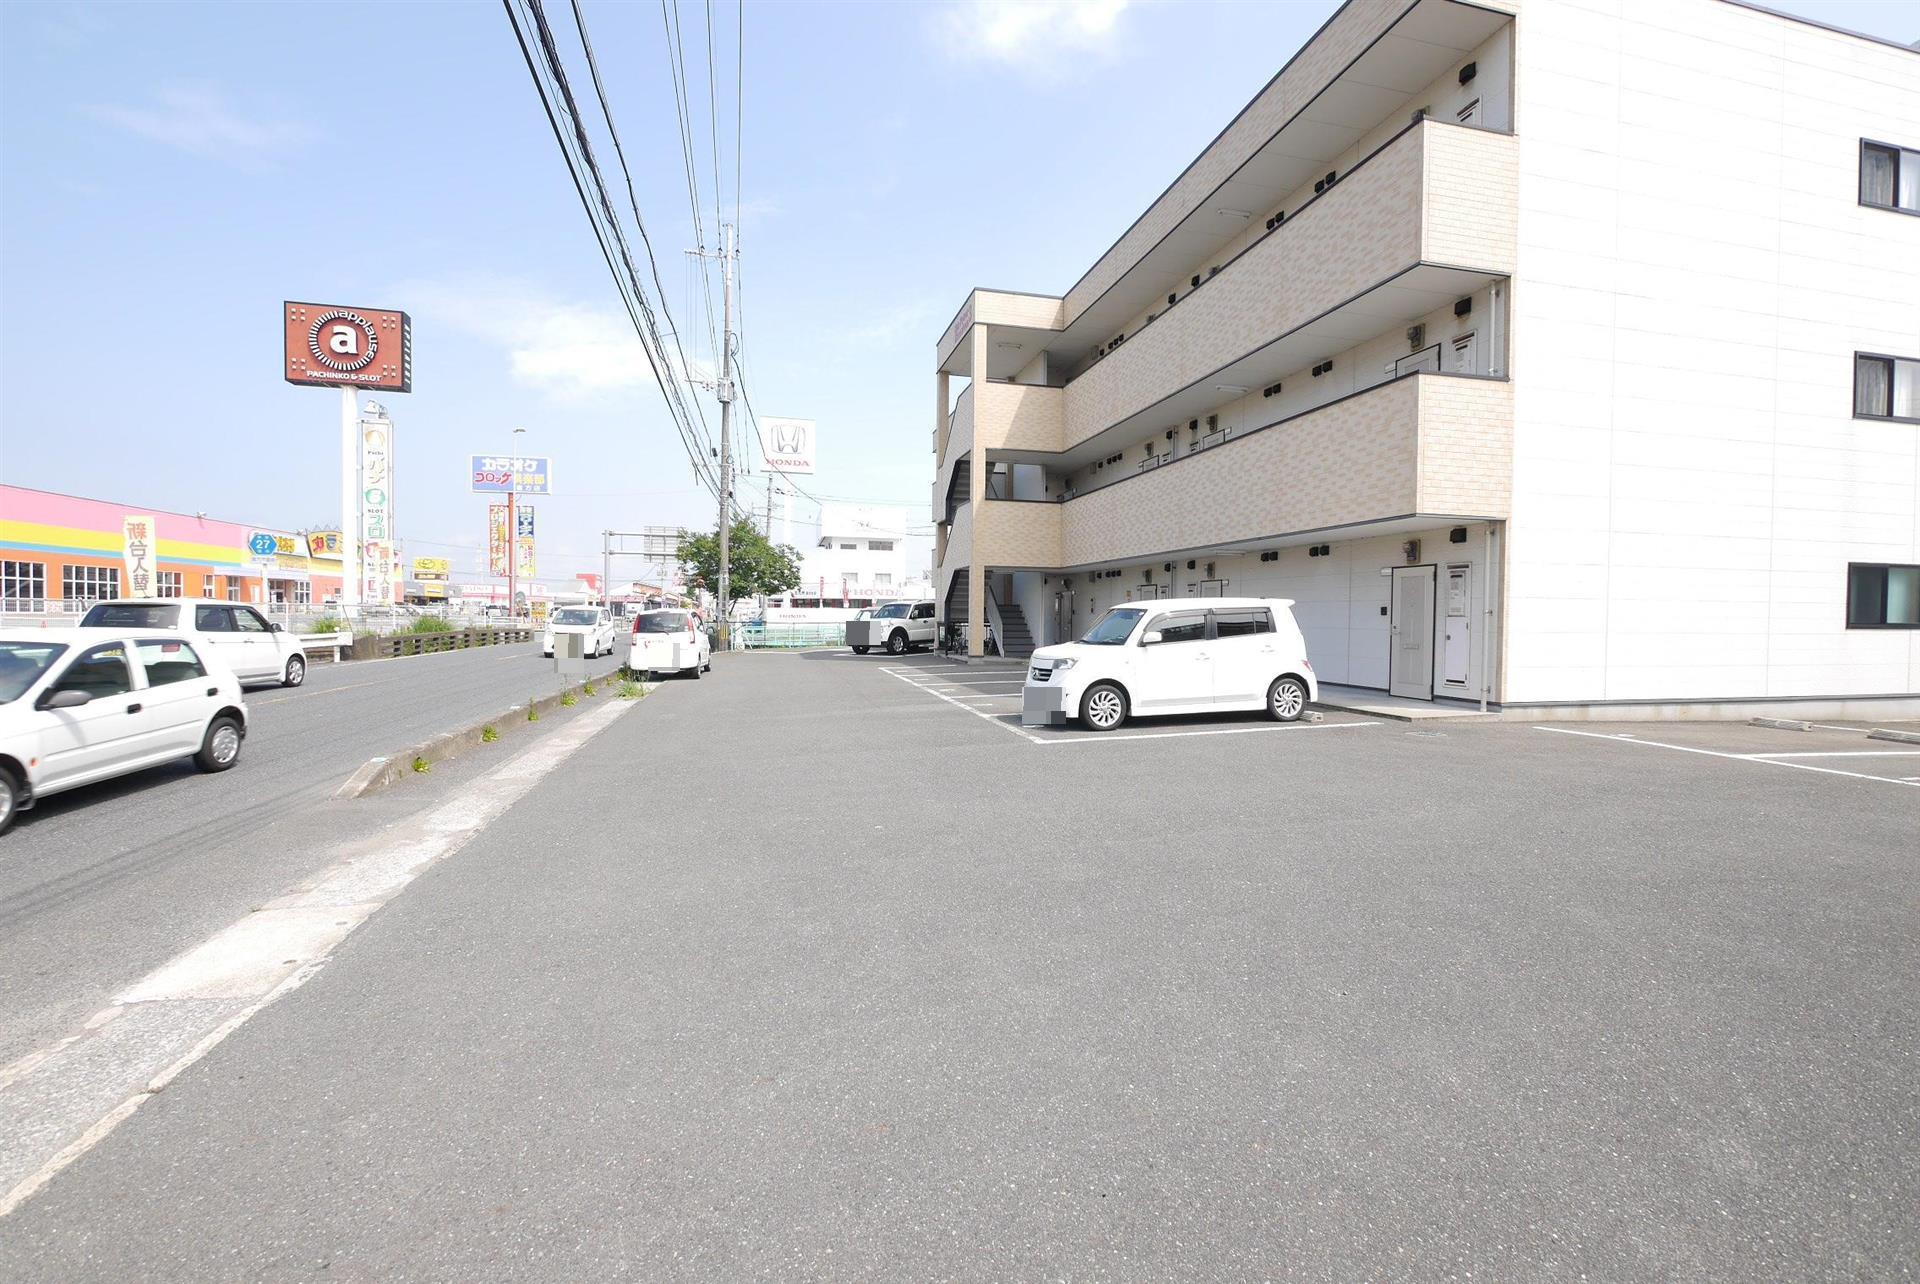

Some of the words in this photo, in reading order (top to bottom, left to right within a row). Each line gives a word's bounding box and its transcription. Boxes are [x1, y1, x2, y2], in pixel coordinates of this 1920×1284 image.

[330, 325, 358, 354] a
[339, 310, 378, 360] applause
[306, 370, 350, 379] PACHINKO
[481, 458, 538, 473] カラオケ
[766, 458, 810, 467] HONDA
[256, 539, 271, 549] 27
